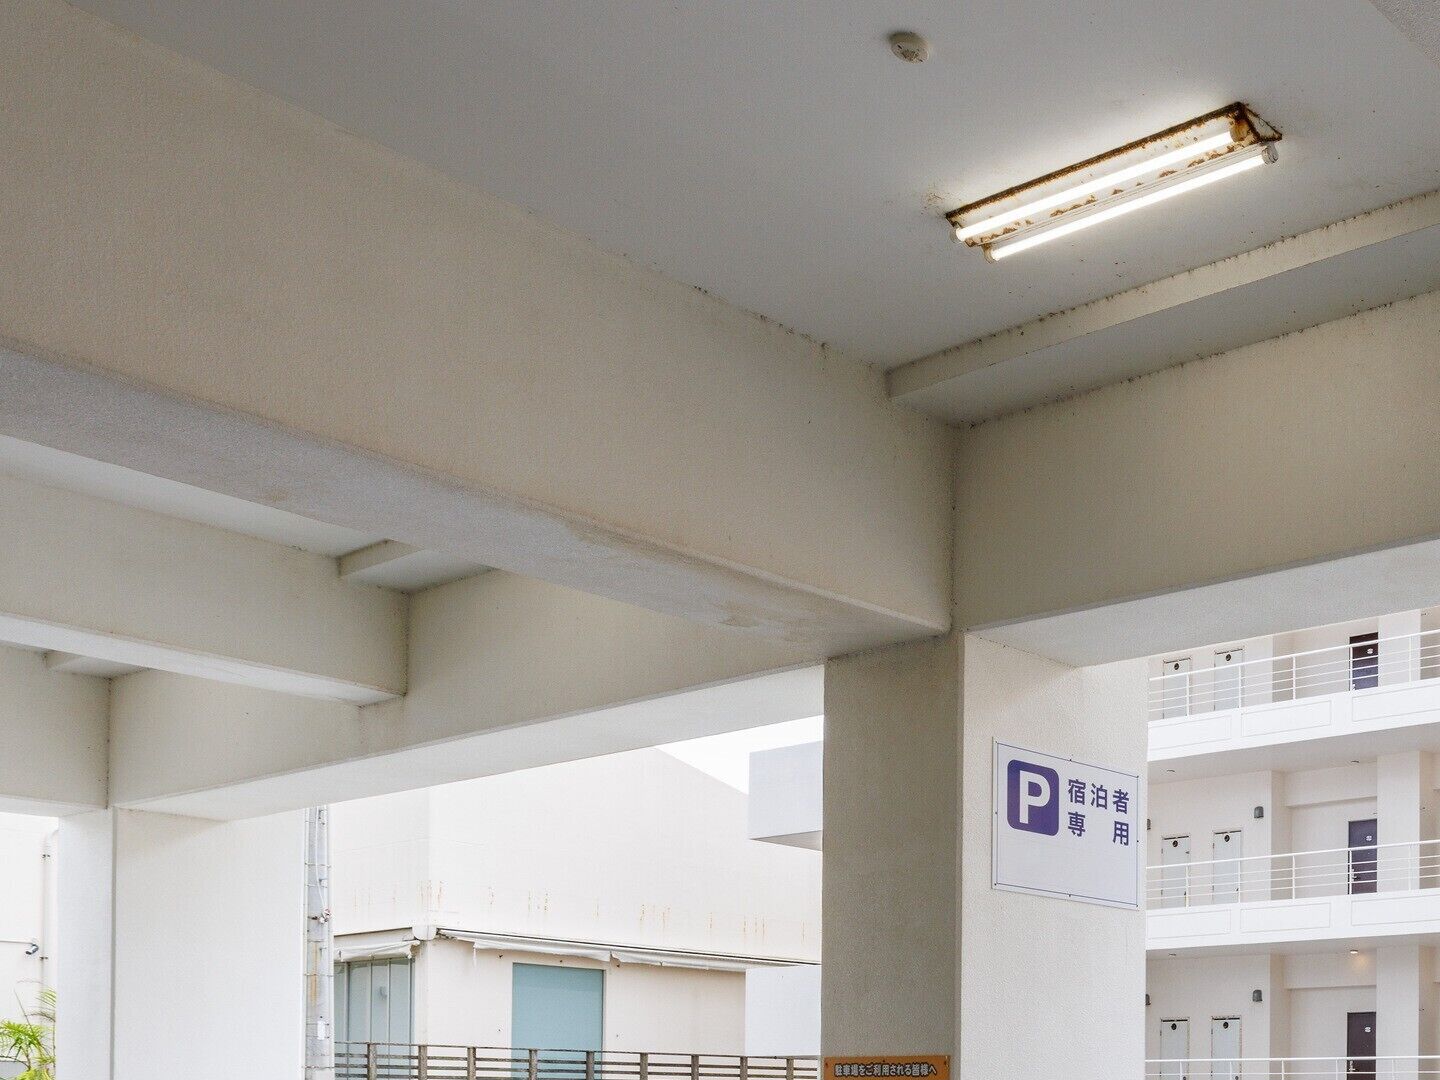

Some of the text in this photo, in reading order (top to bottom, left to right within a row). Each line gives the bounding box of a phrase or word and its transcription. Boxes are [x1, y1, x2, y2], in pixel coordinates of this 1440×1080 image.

[1019, 770, 1051, 824] P
[1067, 779, 1130, 814] 宿泊者
[835, 1063, 937, 1077] 駐車場をご利用される皆様へ
